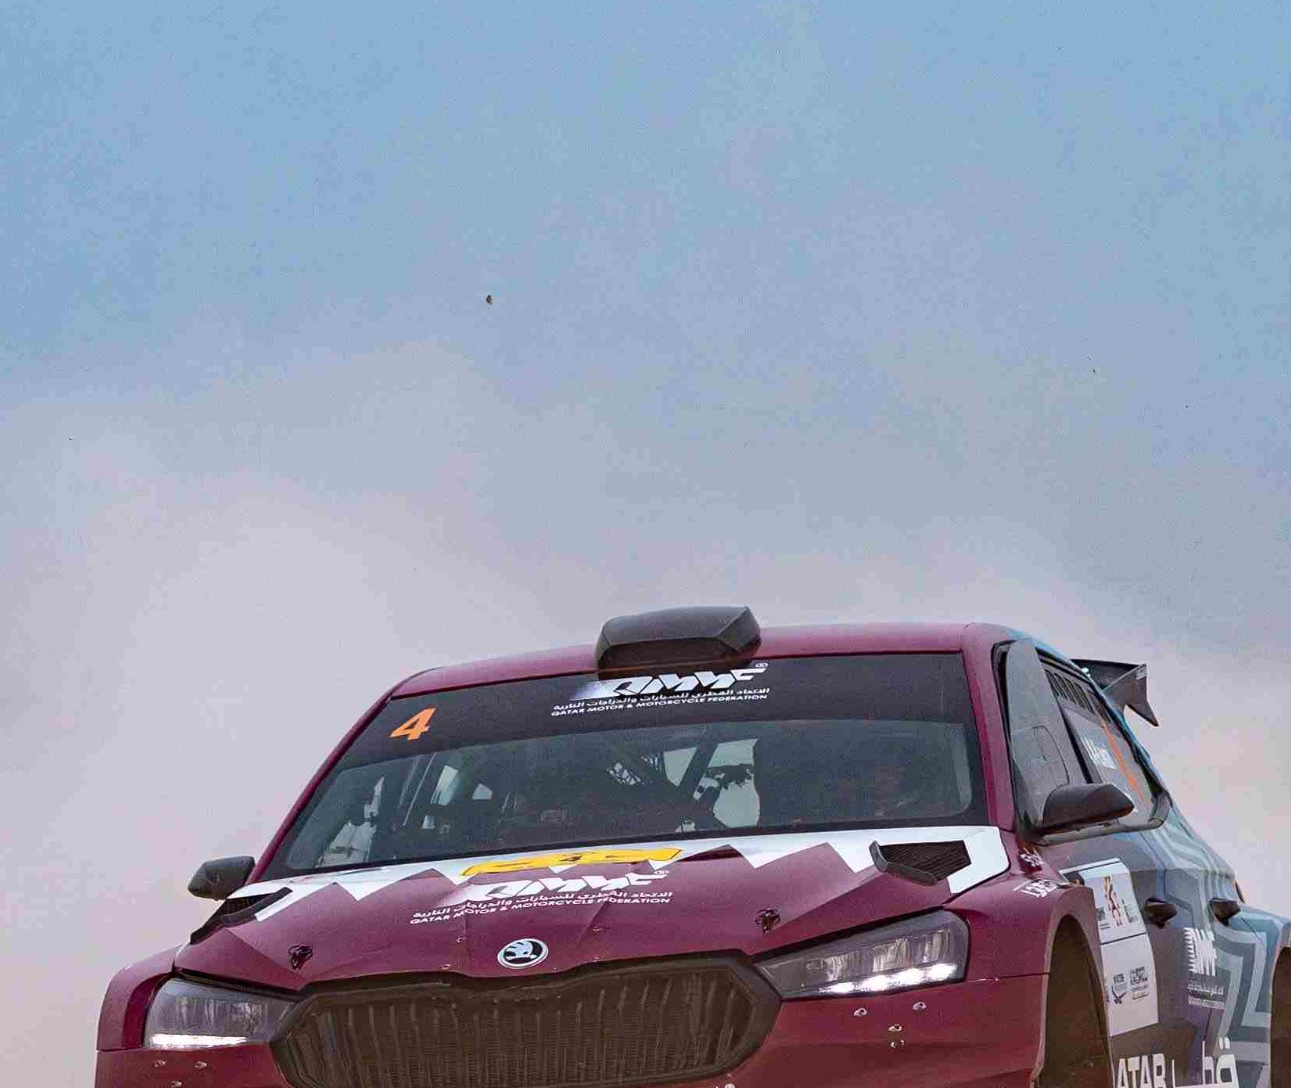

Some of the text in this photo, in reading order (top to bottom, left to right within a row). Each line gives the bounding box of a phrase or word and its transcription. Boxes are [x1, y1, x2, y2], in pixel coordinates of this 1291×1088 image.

[551, 708, 585, 716] QATAR
[587, 704, 623, 712] MOTOR
[636, 697, 706, 707] MOTORCYCLE
[390, 707, 436, 740] 4
[410, 915, 450, 924] QATAR
[454, 907, 497, 918] MOTOR
[511, 899, 594, 909] MOTORCYCLE
